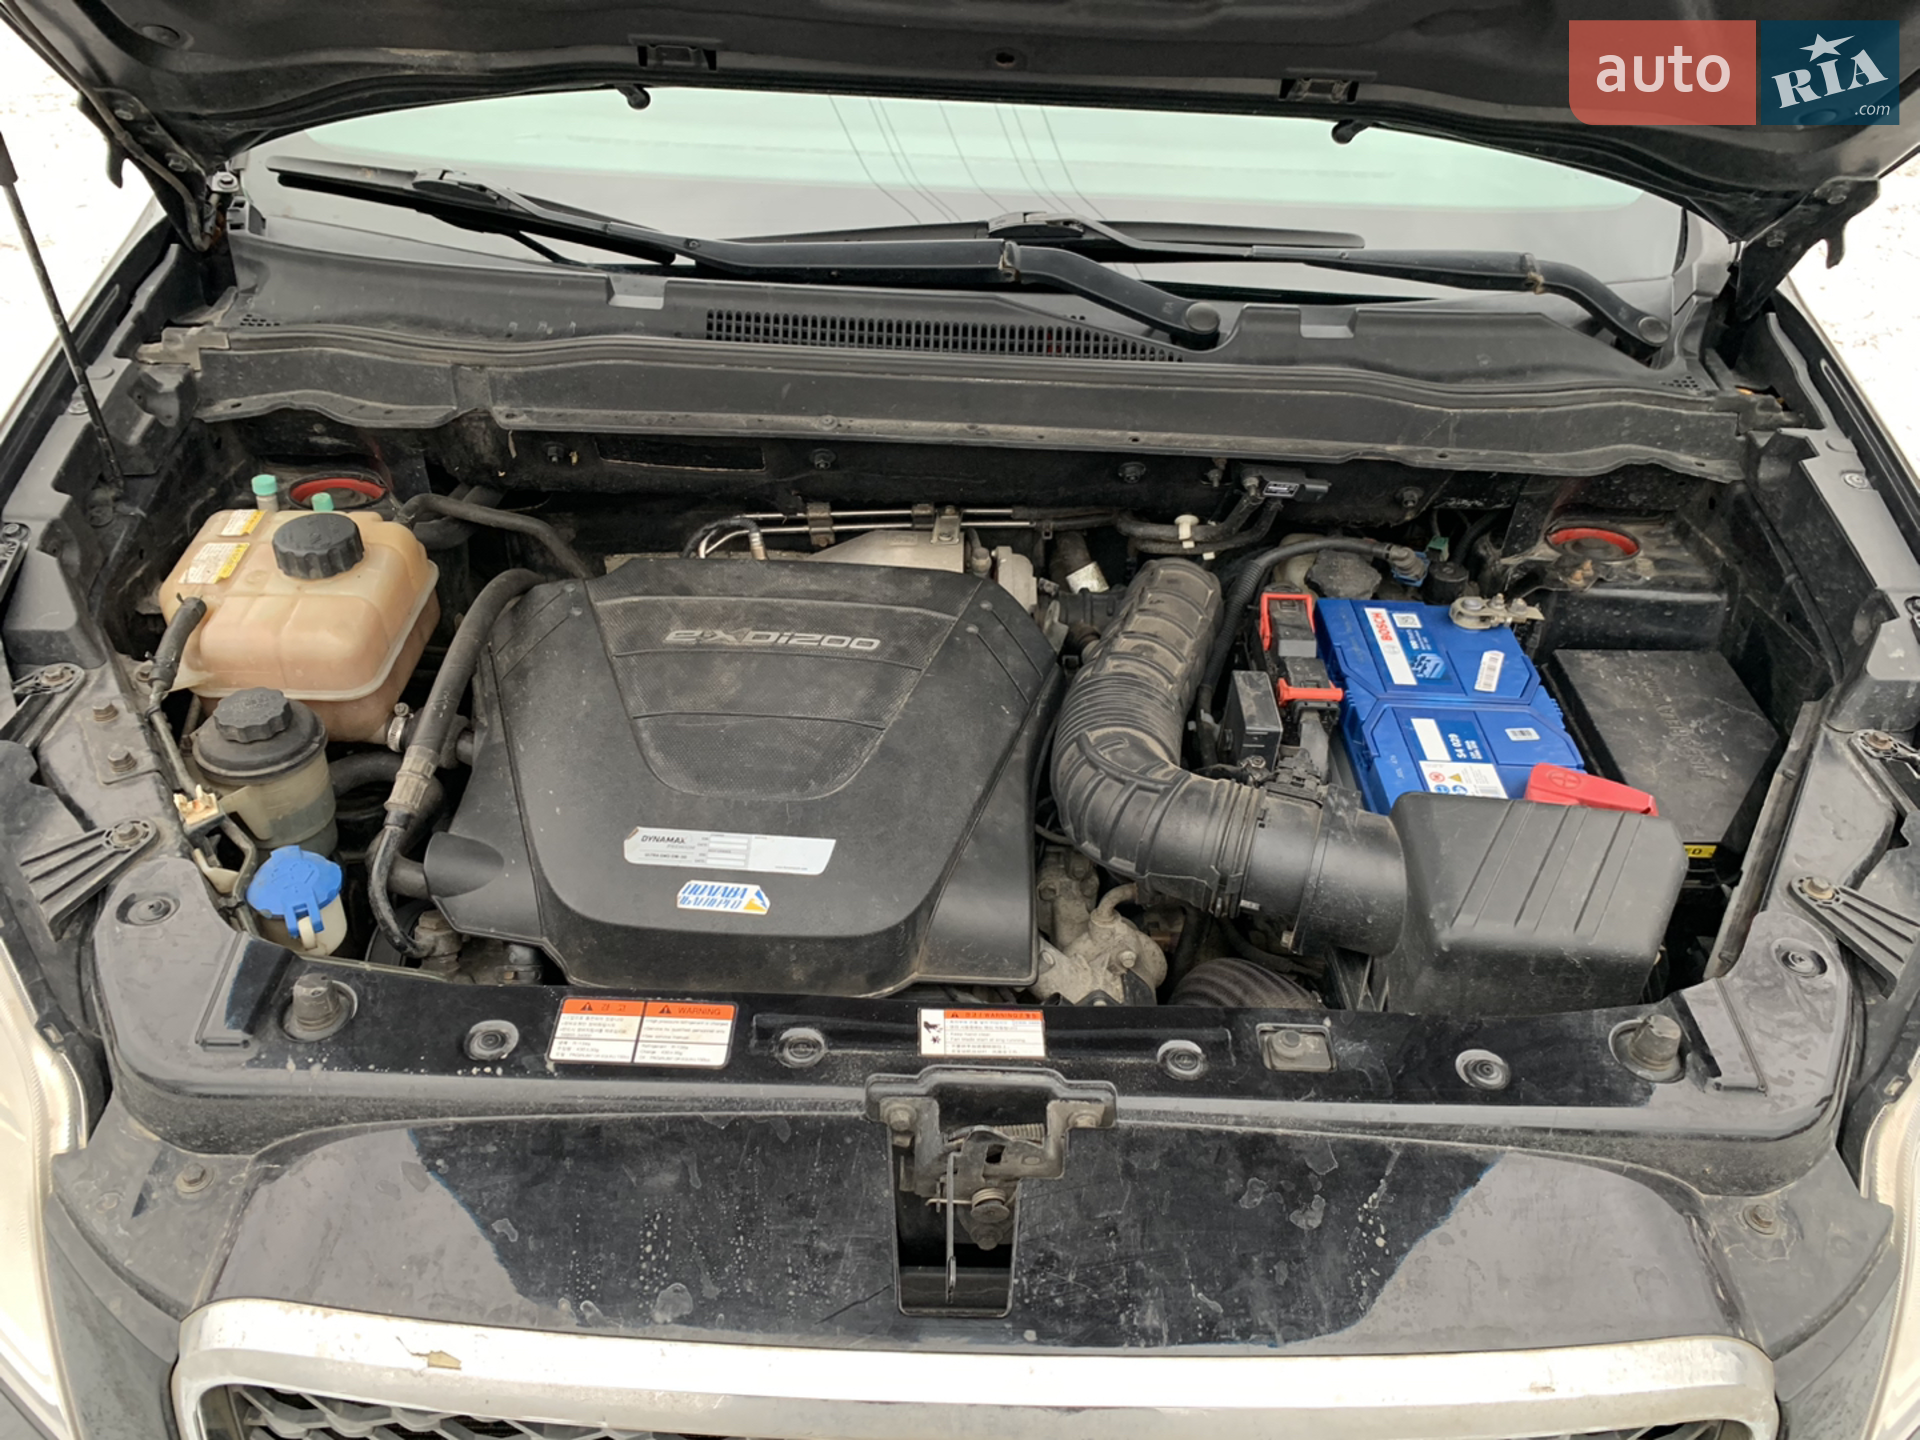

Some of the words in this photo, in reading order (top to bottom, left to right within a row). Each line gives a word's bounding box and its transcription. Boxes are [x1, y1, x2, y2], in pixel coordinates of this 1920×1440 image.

[1371, 612, 1393, 641] BOSCH
[641, 835, 688, 844] DYNAMAX
[677, 1006, 721, 1016] WARNING
